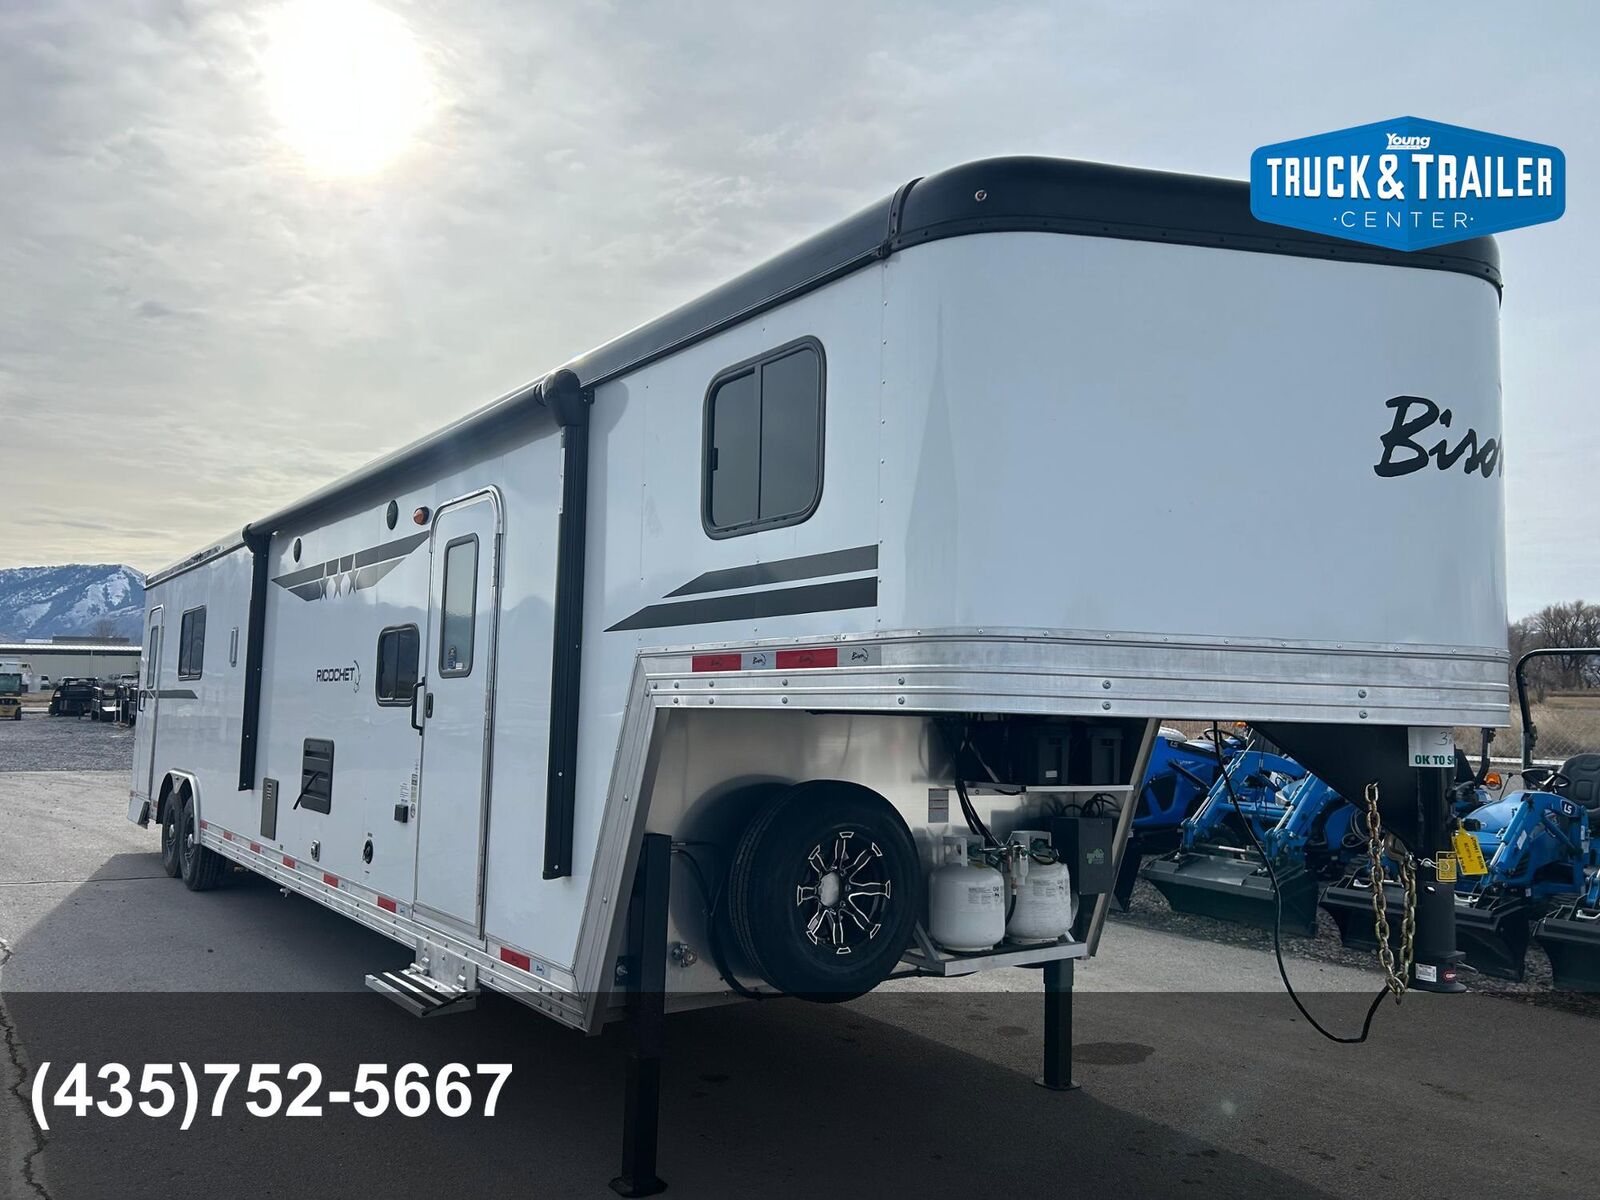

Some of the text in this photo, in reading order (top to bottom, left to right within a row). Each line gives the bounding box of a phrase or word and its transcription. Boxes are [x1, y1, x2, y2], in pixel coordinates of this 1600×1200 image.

[316, 667, 355, 682] RICOCHET
[1415, 754, 1431, 765] OK
[1432, 755, 1446, 765] TO
[1563, 803, 1573, 814] LS
